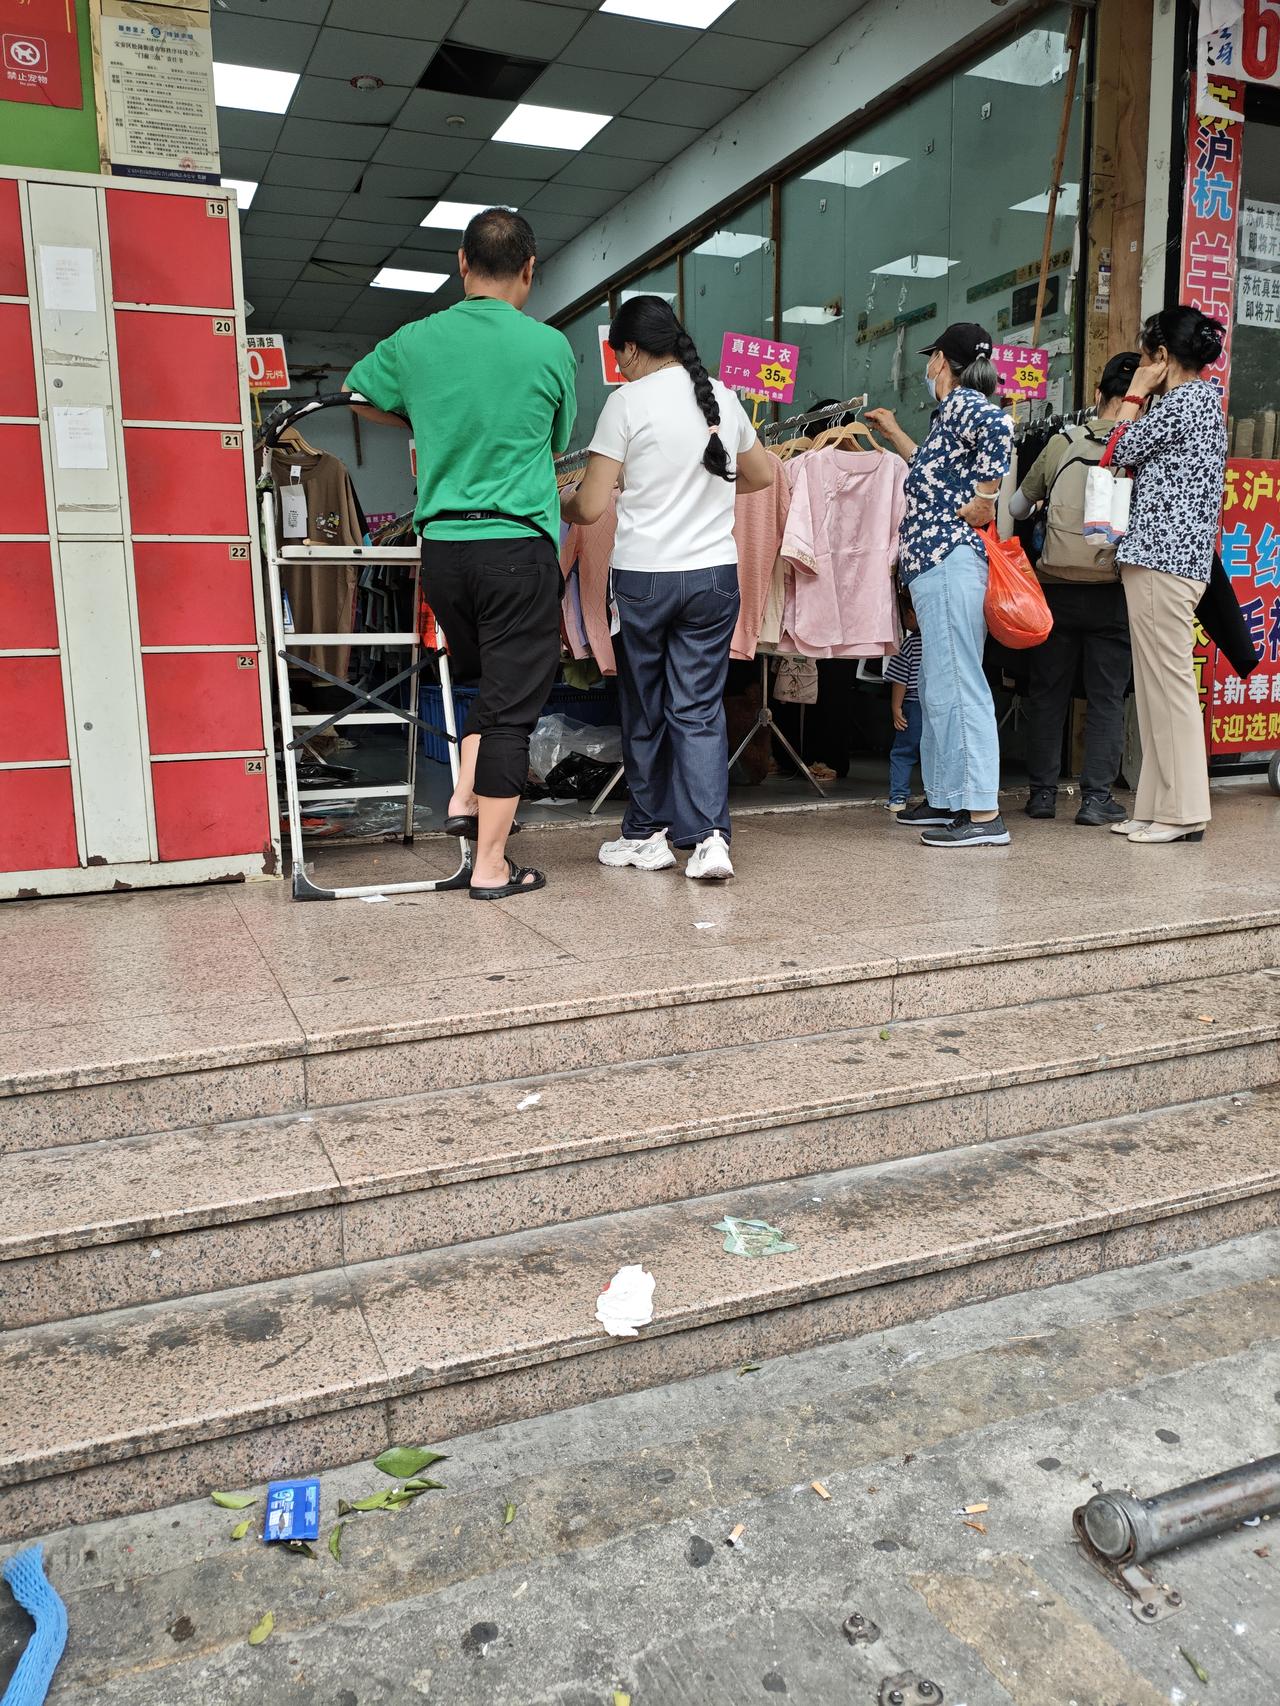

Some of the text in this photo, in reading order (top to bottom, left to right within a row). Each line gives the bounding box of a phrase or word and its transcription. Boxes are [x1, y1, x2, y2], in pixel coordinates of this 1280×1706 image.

[7, 71, 48, 84] 禁止宠物
[209, 203, 224, 215] 19
[1249, 232, 1280, 256] 即将开
[1242, 274, 1280, 298] 苏杭真丝
[215, 321, 231, 332] 20
[732, 338, 791, 363] 真丝上衣
[991, 347, 1042, 364] 真丝上衣
[725, 365, 786, 383] 工厂价 35元
[225, 435, 239, 446] 21
[1224, 468, 1280, 512] 苏沪
[232, 547, 246, 558] 22
[240, 656, 254, 666] 23
[248, 761, 262, 772] 24
